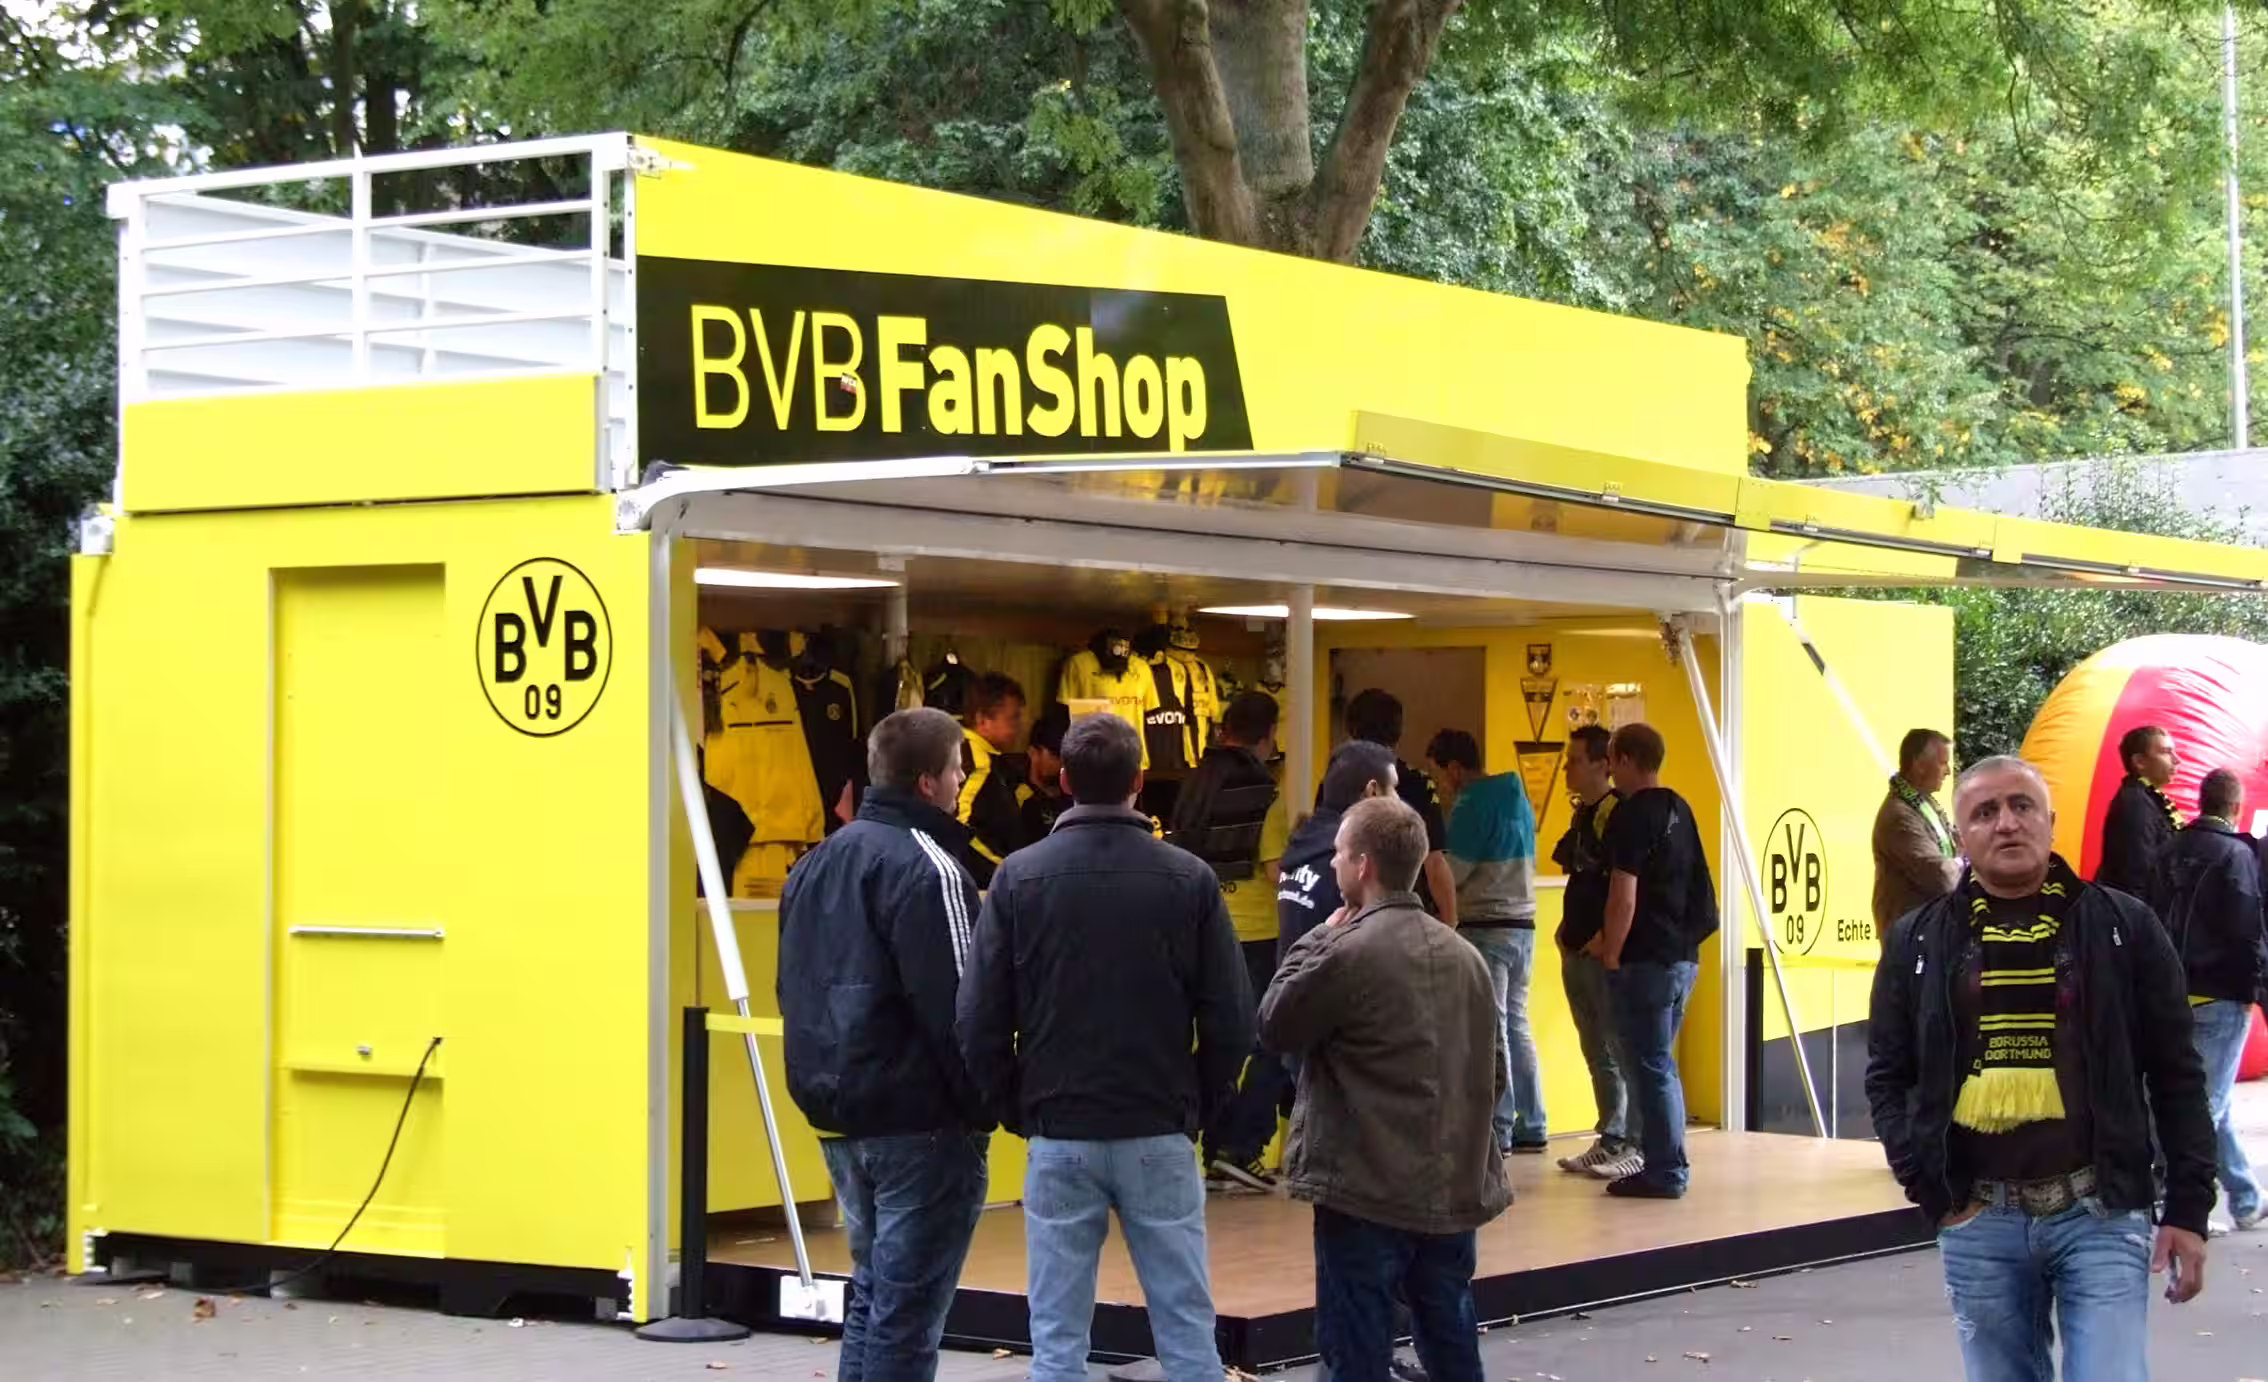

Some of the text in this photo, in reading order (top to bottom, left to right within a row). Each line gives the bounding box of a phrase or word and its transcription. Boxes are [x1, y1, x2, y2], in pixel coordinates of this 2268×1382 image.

[691, 304, 1208, 453] BVB FanShop
[494, 575, 598, 683] BVB
[524, 683, 562, 720] 09
[1771, 823, 1821, 914] BVB
[1786, 914, 1805, 945] 09
[1837, 919, 1871, 942] Echte
[1984, 1047, 2052, 1061] DORTMUND
[1989, 1035, 2049, 1049] BORUSSIA
